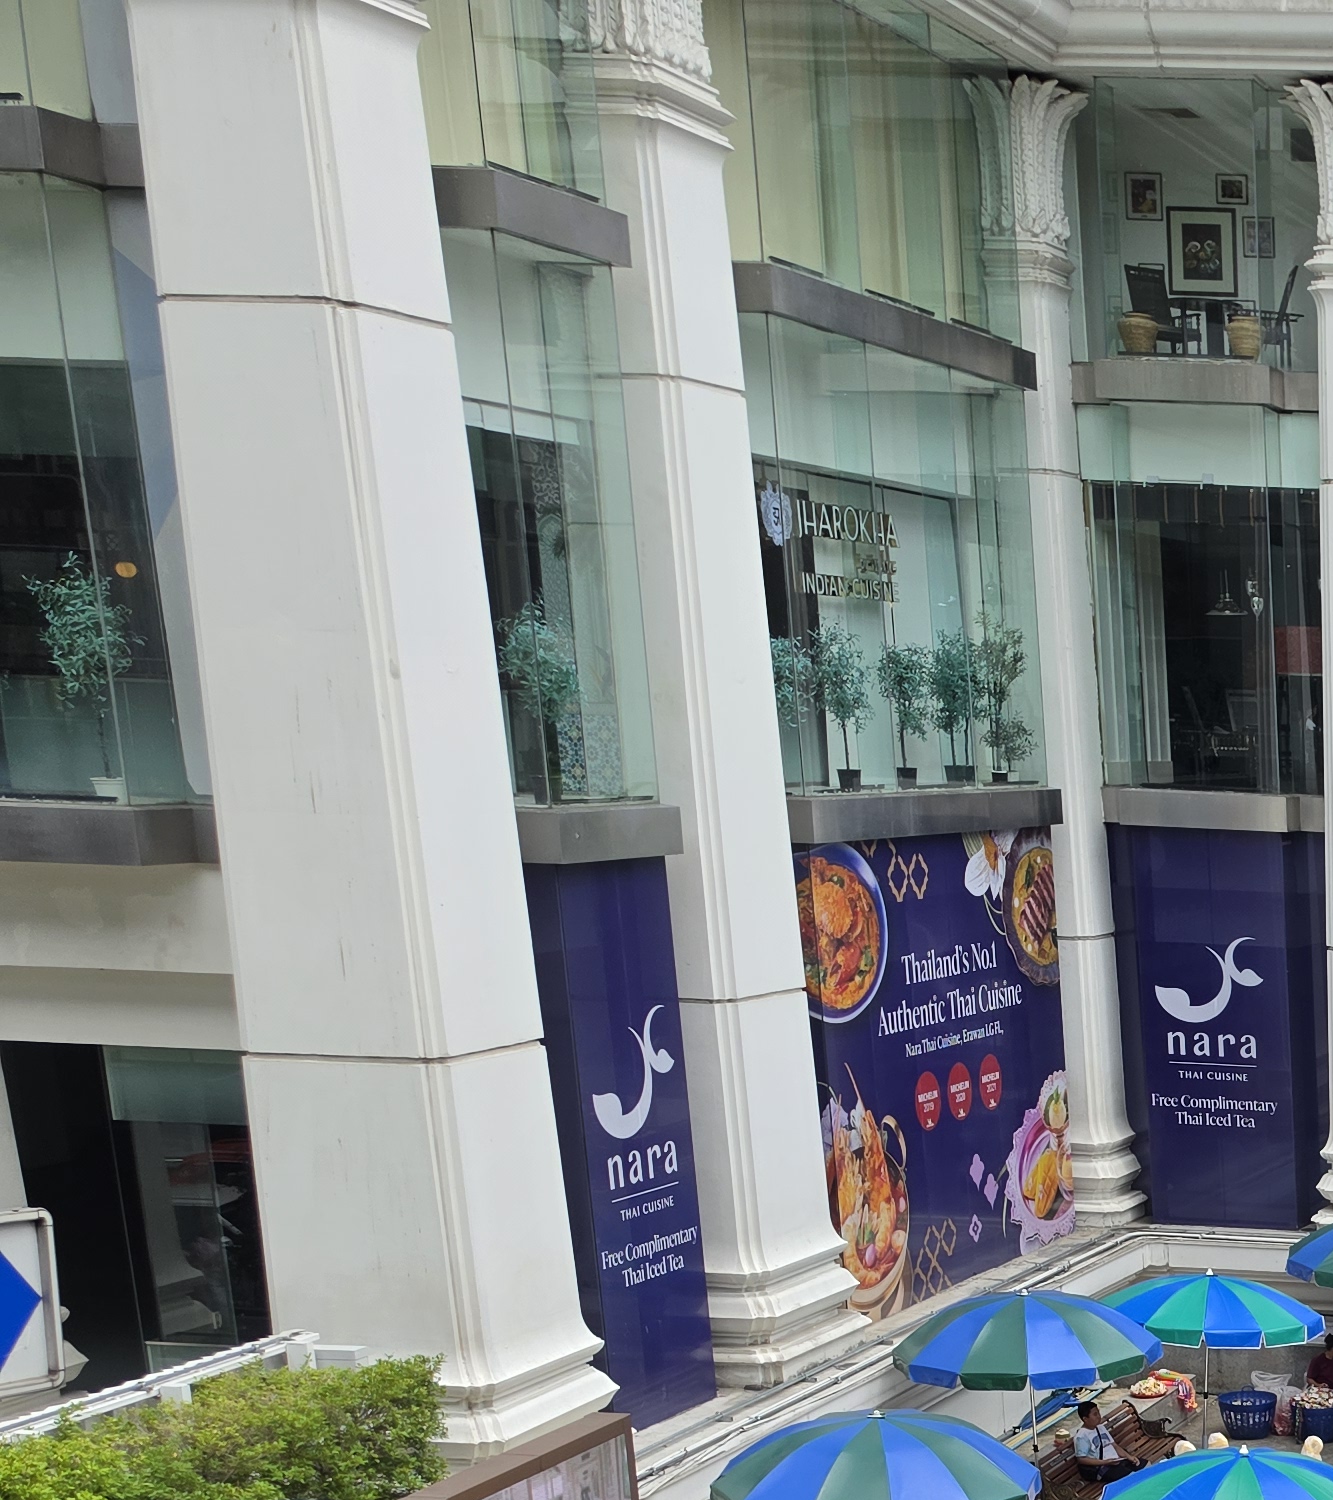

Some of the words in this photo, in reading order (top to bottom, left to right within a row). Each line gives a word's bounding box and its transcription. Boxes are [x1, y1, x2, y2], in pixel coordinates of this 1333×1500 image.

[795, 500, 899, 547] JHAROKHA
[802, 572, 847, 597] INDIAN
[853, 578, 899, 603] CUISINE
[901, 945, 970, 985] Thailand's
[971, 940, 997, 972] No.1
[878, 994, 946, 1037] Authentic
[947, 986, 977, 1020] Thai
[978, 979, 1023, 1013] Cuisine
[905, 1039, 922, 1058] Nara
[922, 1036, 937, 1052] Thai
[1167, 1031, 1257, 1059] nara
[1178, 1070, 1203, 1080] THAI
[1206, 1071, 1249, 1082] CUISINE
[1151, 1093, 1178, 1107] Free
[1180, 1095, 1278, 1116] Complimentary
[1175, 1111, 1203, 1126] Thai
[1205, 1113, 1232, 1127] Iced
[1233, 1114, 1256, 1128] Tea
[607, 1140, 678, 1190] nara
[620, 1205, 640, 1221] THAI
[643, 1195, 674, 1215] CUISINE
[601, 1251, 624, 1270] Free
[625, 1226, 698, 1262] Complimentary
[622, 1264, 645, 1287] Thai
[646, 1255, 667, 1280] Iced
[667, 1253, 685, 1272] Tea
